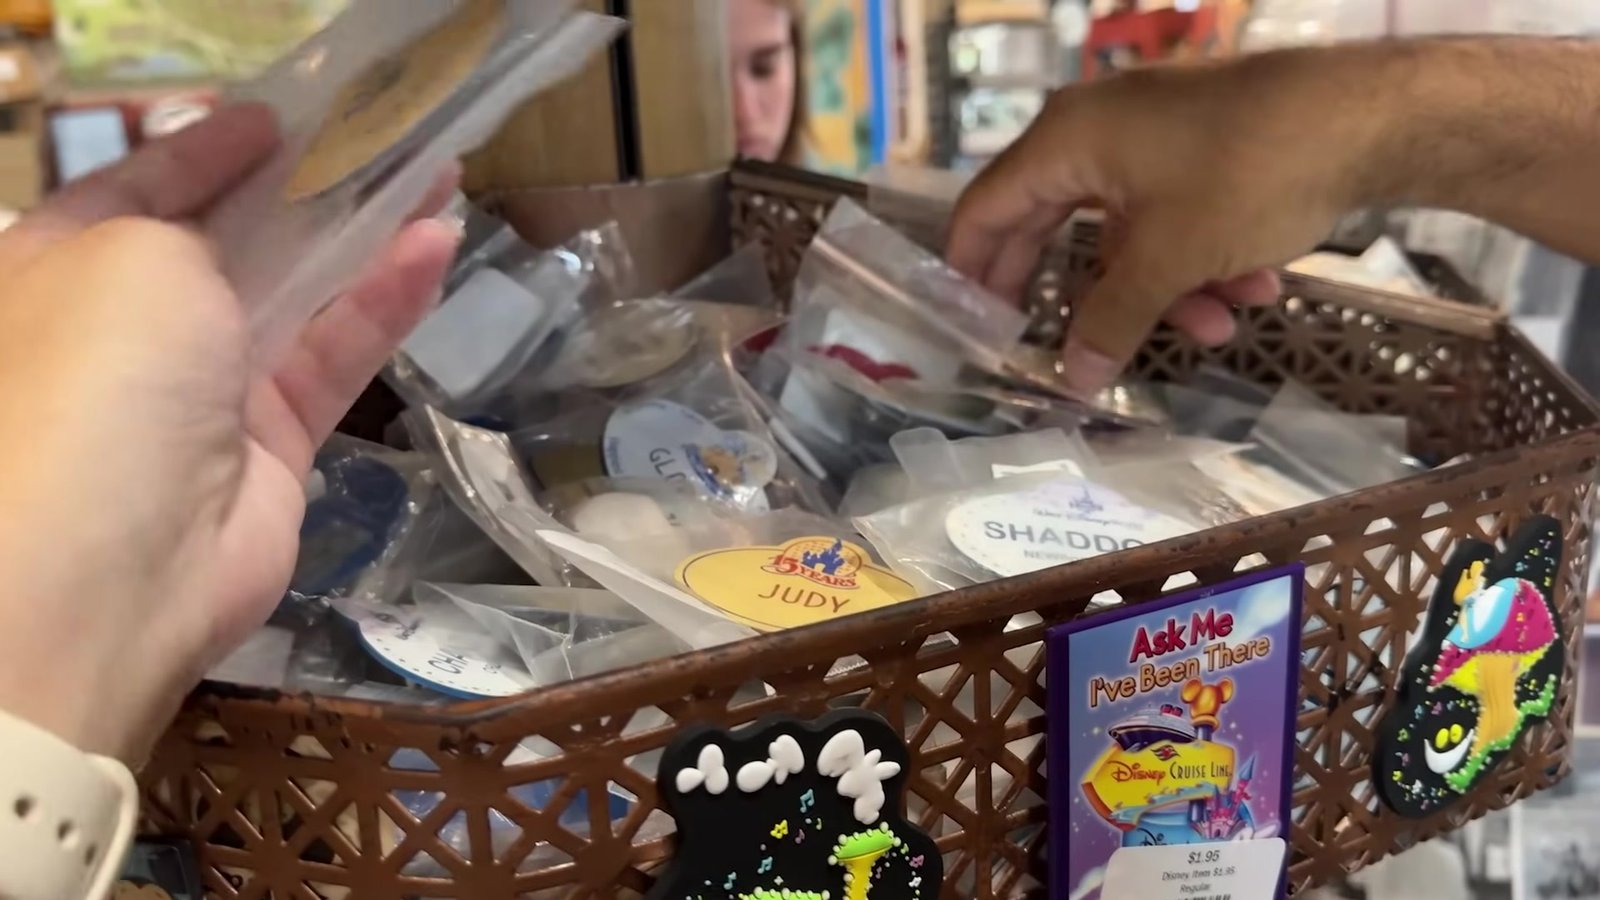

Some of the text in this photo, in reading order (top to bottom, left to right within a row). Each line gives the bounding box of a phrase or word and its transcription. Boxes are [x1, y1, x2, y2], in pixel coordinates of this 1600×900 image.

[767, 555, 857, 587] 15 YEARS
[758, 583, 851, 613] JUDY
[1130, 608, 1234, 663] Ask Me
[1089, 637, 1270, 708] I've Been There
[1107, 760, 1166, 786] Disney
[1187, 849, 1221, 864] $1.95
